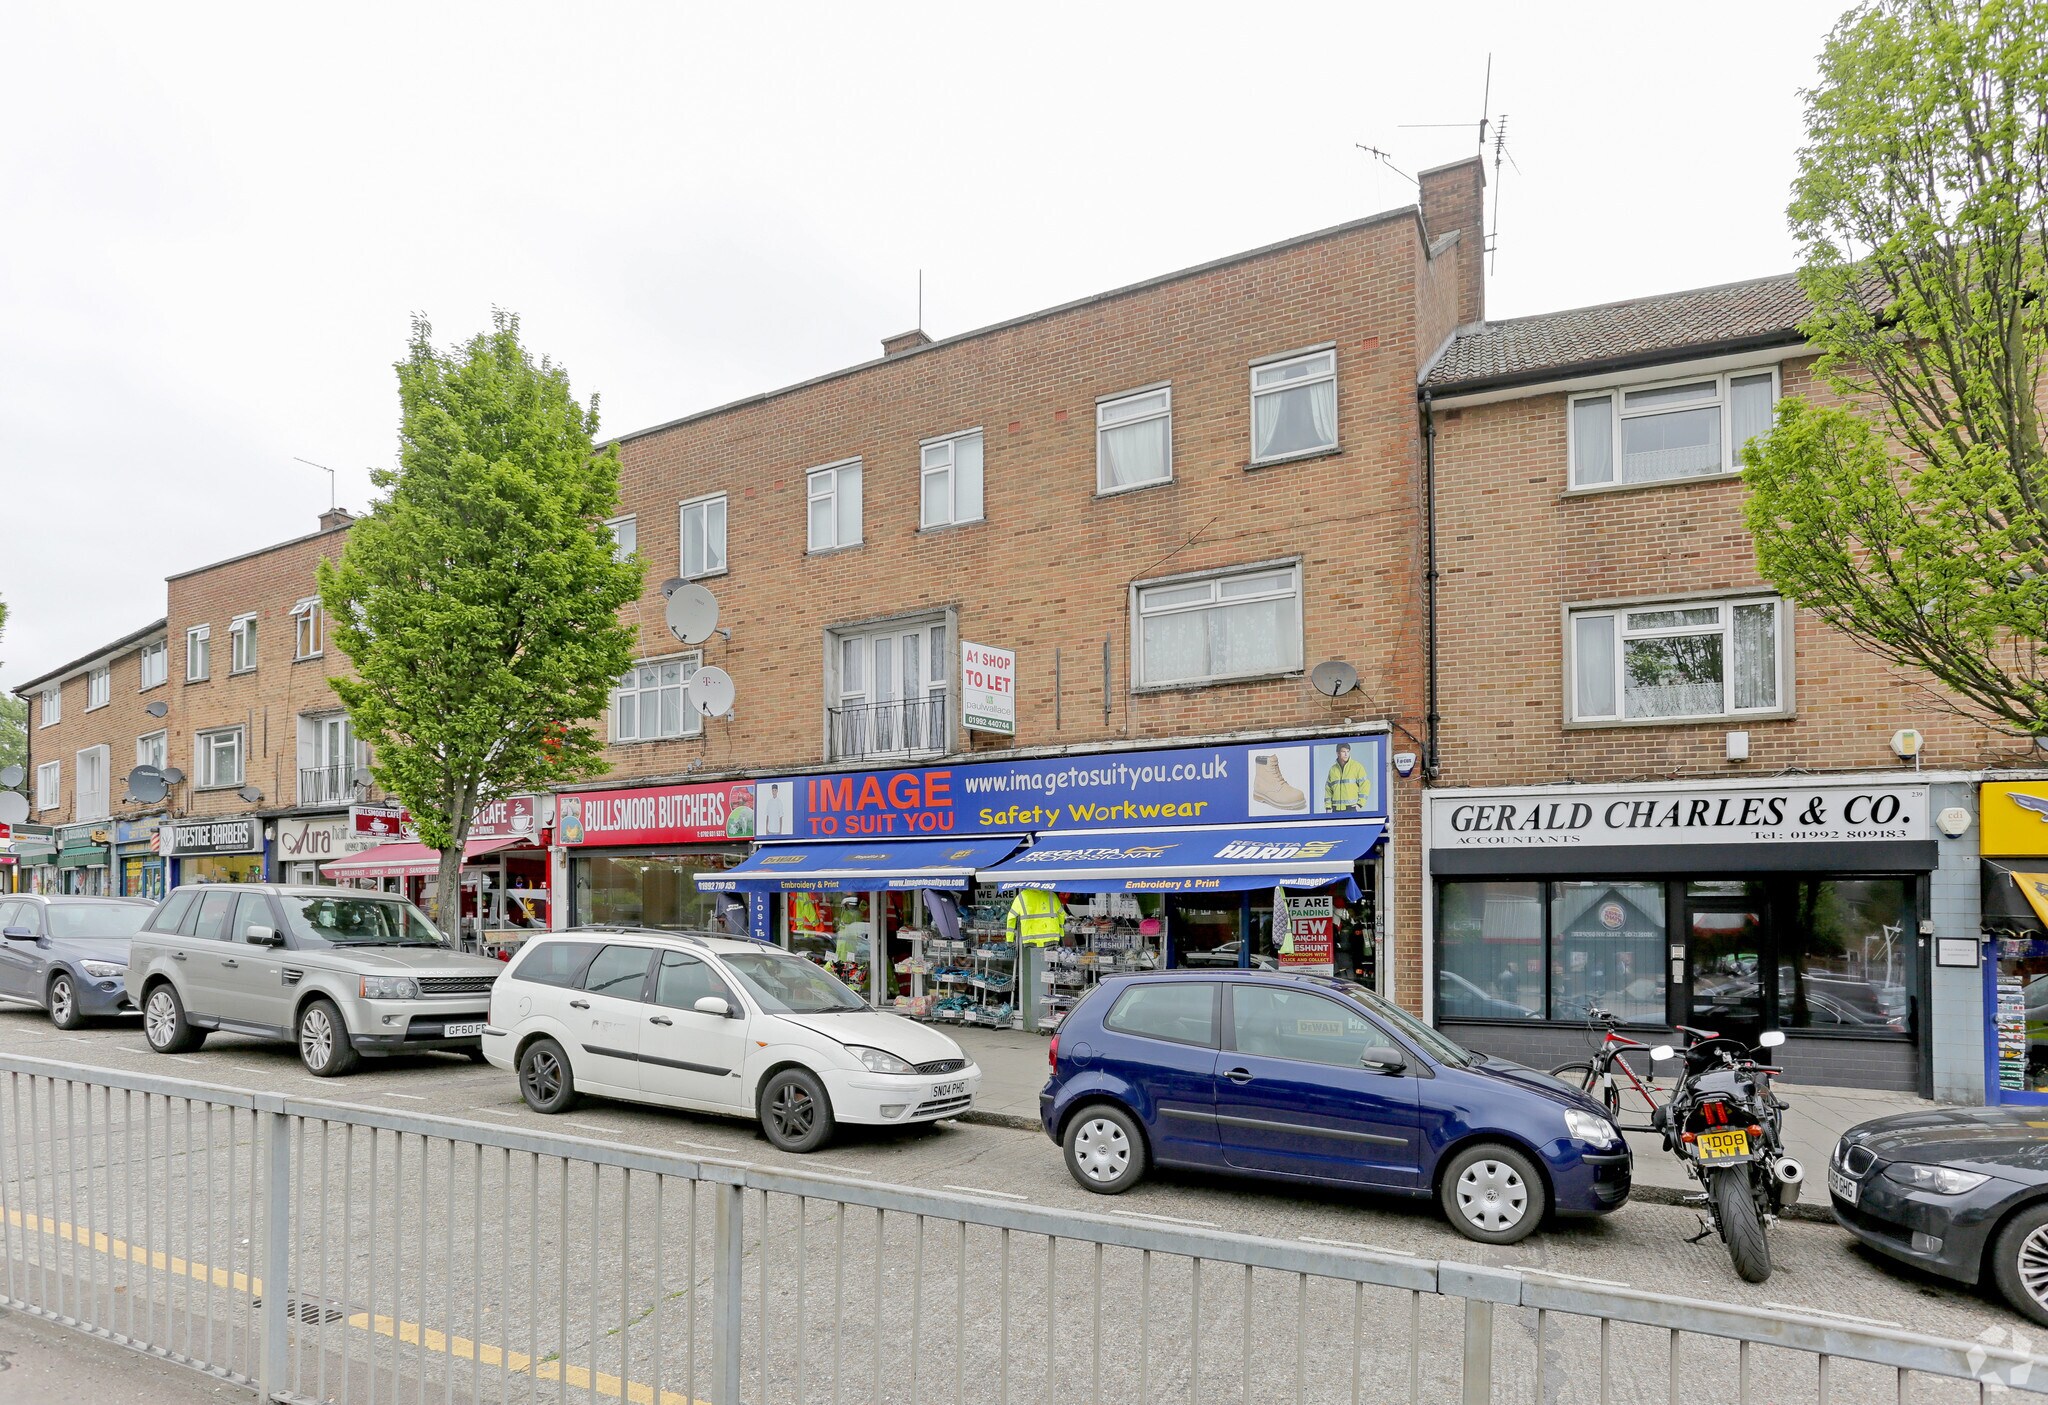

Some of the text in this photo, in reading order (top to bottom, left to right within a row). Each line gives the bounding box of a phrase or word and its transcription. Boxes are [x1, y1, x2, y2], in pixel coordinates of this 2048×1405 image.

[966, 650, 1011, 670] A1 SHOP
[966, 669, 1011, 693] TO LET
[968, 716, 1010, 730] 01992 440744
[965, 754, 1228, 795] www.imagetosuityou.co.uk
[808, 771, 953, 813] IMAGE
[482, 803, 508, 824] CAFE
[585, 792, 726, 832] BULLSMOOR BUTCHERS
[979, 801, 1209, 828] Safety Workwear
[1450, 794, 1911, 832] GERALD CHARLES & CO.
[808, 811, 954, 835] TO SUIT YOU
[175, 822, 249, 848] PRESTIGE BARBERS
[1455, 835, 1581, 844] ACCOUNTANTS
[1790, 830, 1839, 839] 01992
[1846, 829, 1908, 839] 809183
[1230, 839, 1302, 848] REGATTA
[1025, 847, 1121, 858] REGATTA
[1214, 845, 1301, 860] HARD
[780, 879, 840, 890] Embroidery & Print
[1125, 878, 1220, 890] Embroidery & Print
[977, 890, 1014, 899] WE ARE
[1304, 898, 1329, 908] ARE
[1289, 909, 1330, 917] PANDING
[1318, 934, 1327, 942] IN
[1295, 944, 1329, 952] ESHUNT
[448, 1024, 474, 1035] GF60
[933, 1081, 965, 1097] SN04 PHG
